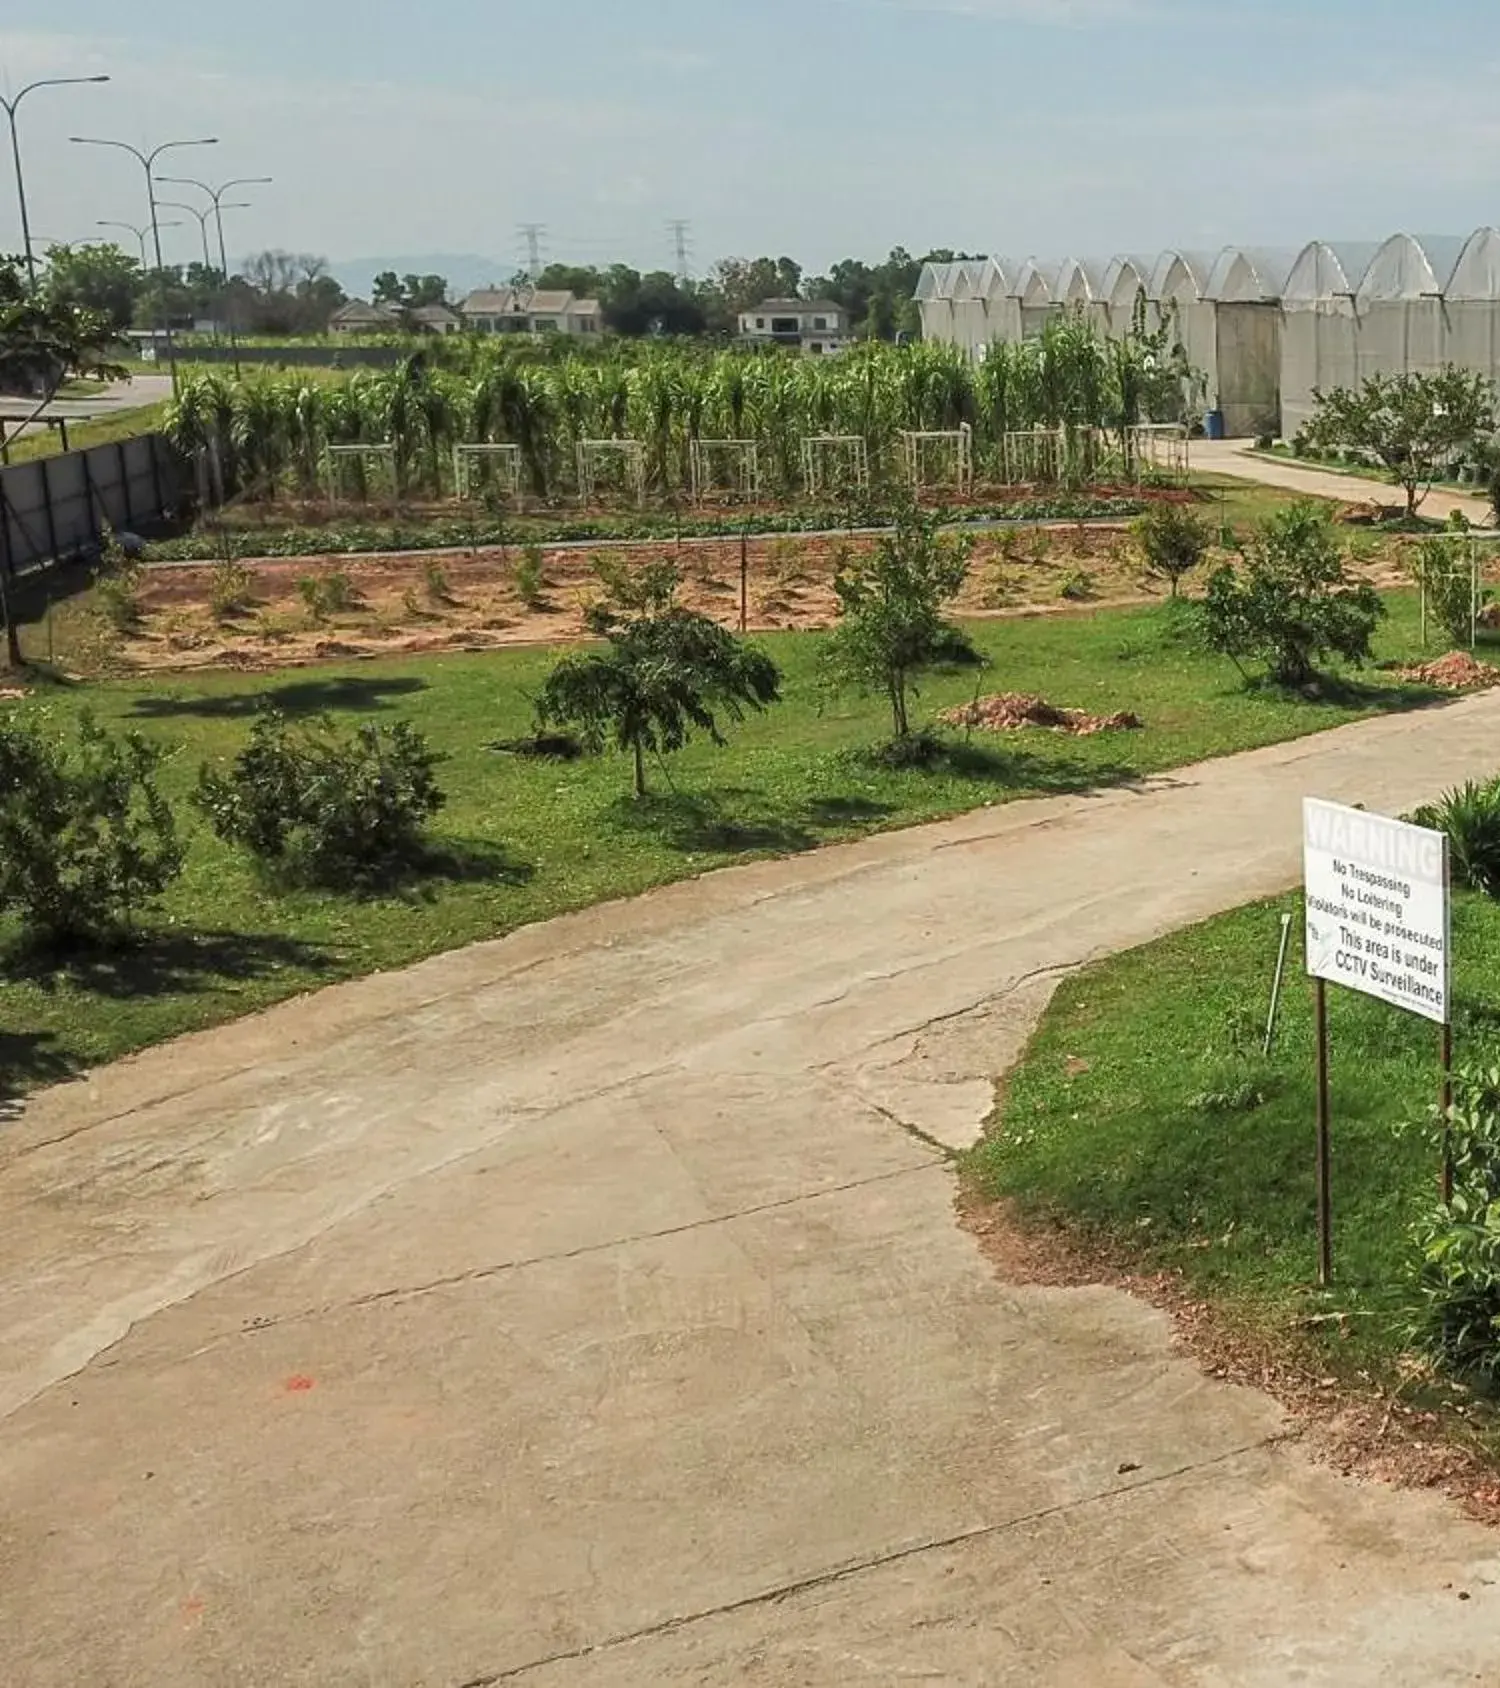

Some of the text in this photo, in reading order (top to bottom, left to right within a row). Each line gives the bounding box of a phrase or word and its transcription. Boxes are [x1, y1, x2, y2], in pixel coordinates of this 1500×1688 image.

[1306, 806, 1440, 877] WARNING
[1333, 859, 1410, 898] No Trespassing
[1341, 883, 1402, 918] No Loitering
[1339, 926, 1362, 950] This
[1365, 937, 1389, 959] area
[1392, 944, 1401, 965] is
[1404, 954, 1438, 977] under
[1350, 909, 1367, 929] will
[1369, 912, 1382, 931] be
[1384, 922, 1442, 951] prosecuted
[1335, 950, 1367, 977] CCTV
[1370, 962, 1443, 1005] Surveillance
